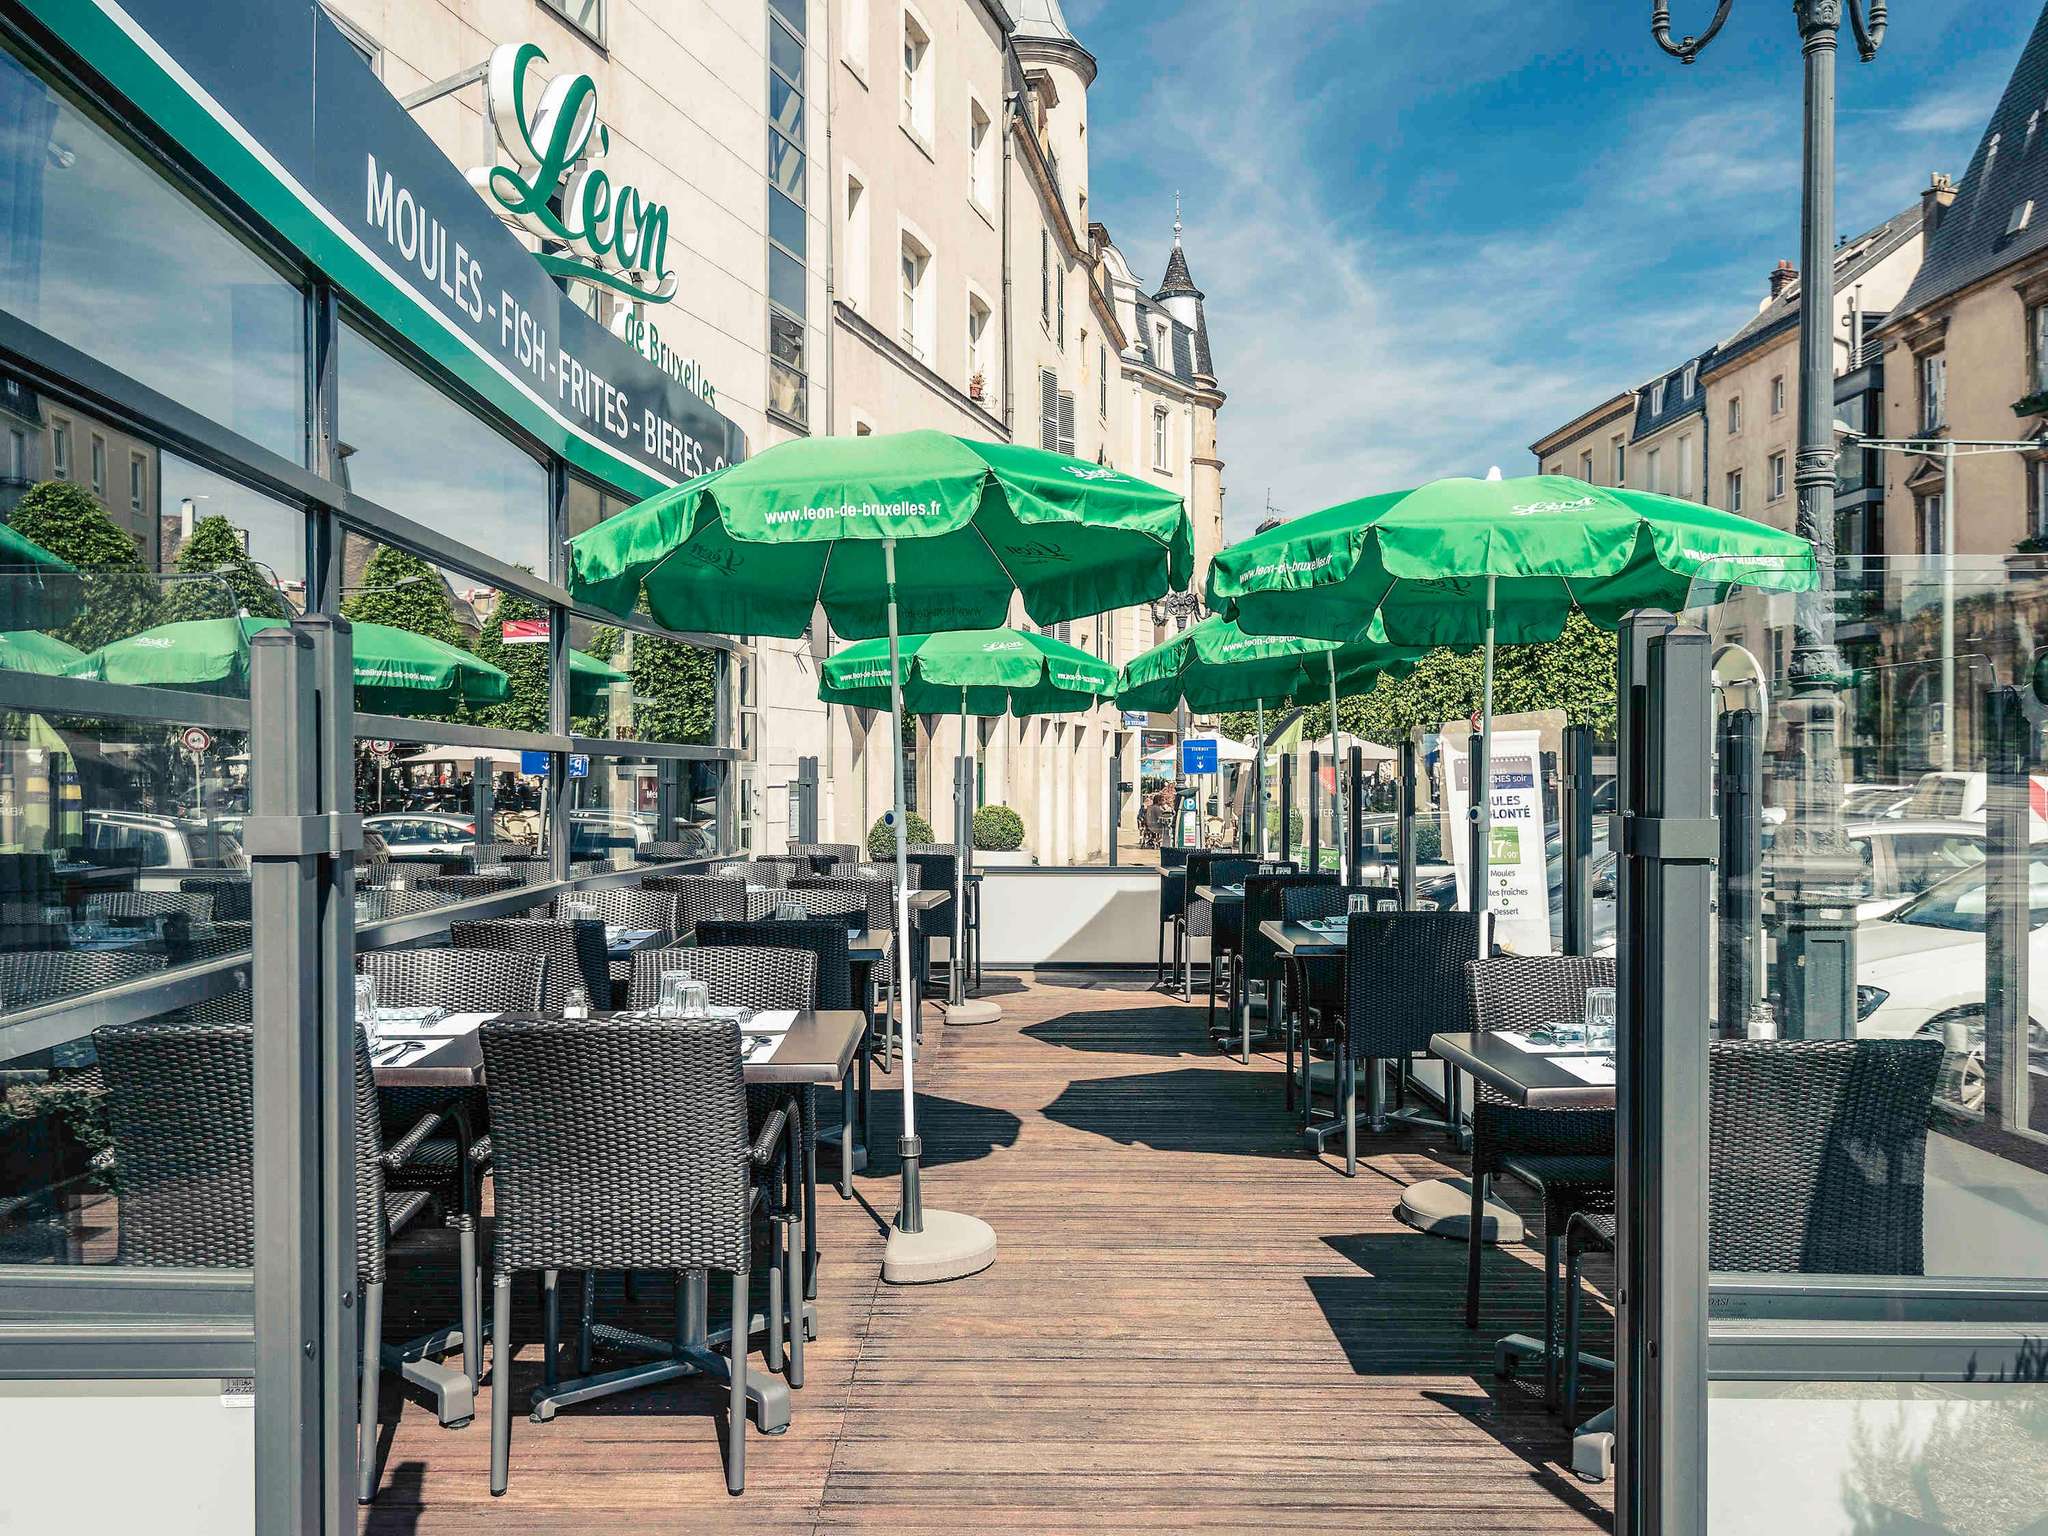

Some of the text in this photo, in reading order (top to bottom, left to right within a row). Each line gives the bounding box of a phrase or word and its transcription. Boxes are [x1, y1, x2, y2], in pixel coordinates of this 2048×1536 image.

[366, 152, 484, 324] MOULES
[501, 289, 547, 384] FISH
[558, 346, 630, 439] FRITES
[643, 407, 704, 479] BIERES
[625, 302, 717, 410] de Bruxelles
[764, 500, 942, 525] www.leon-de-bruxelles.fr
[1239, 553, 1333, 584] www.leon-de-bruxelles.fr
[1512, 773, 1527, 783] soir
[1490, 869, 1516, 878] Moules
[1500, 887, 1529, 898] fraîches
[1493, 907, 1519, 916] Dessert
